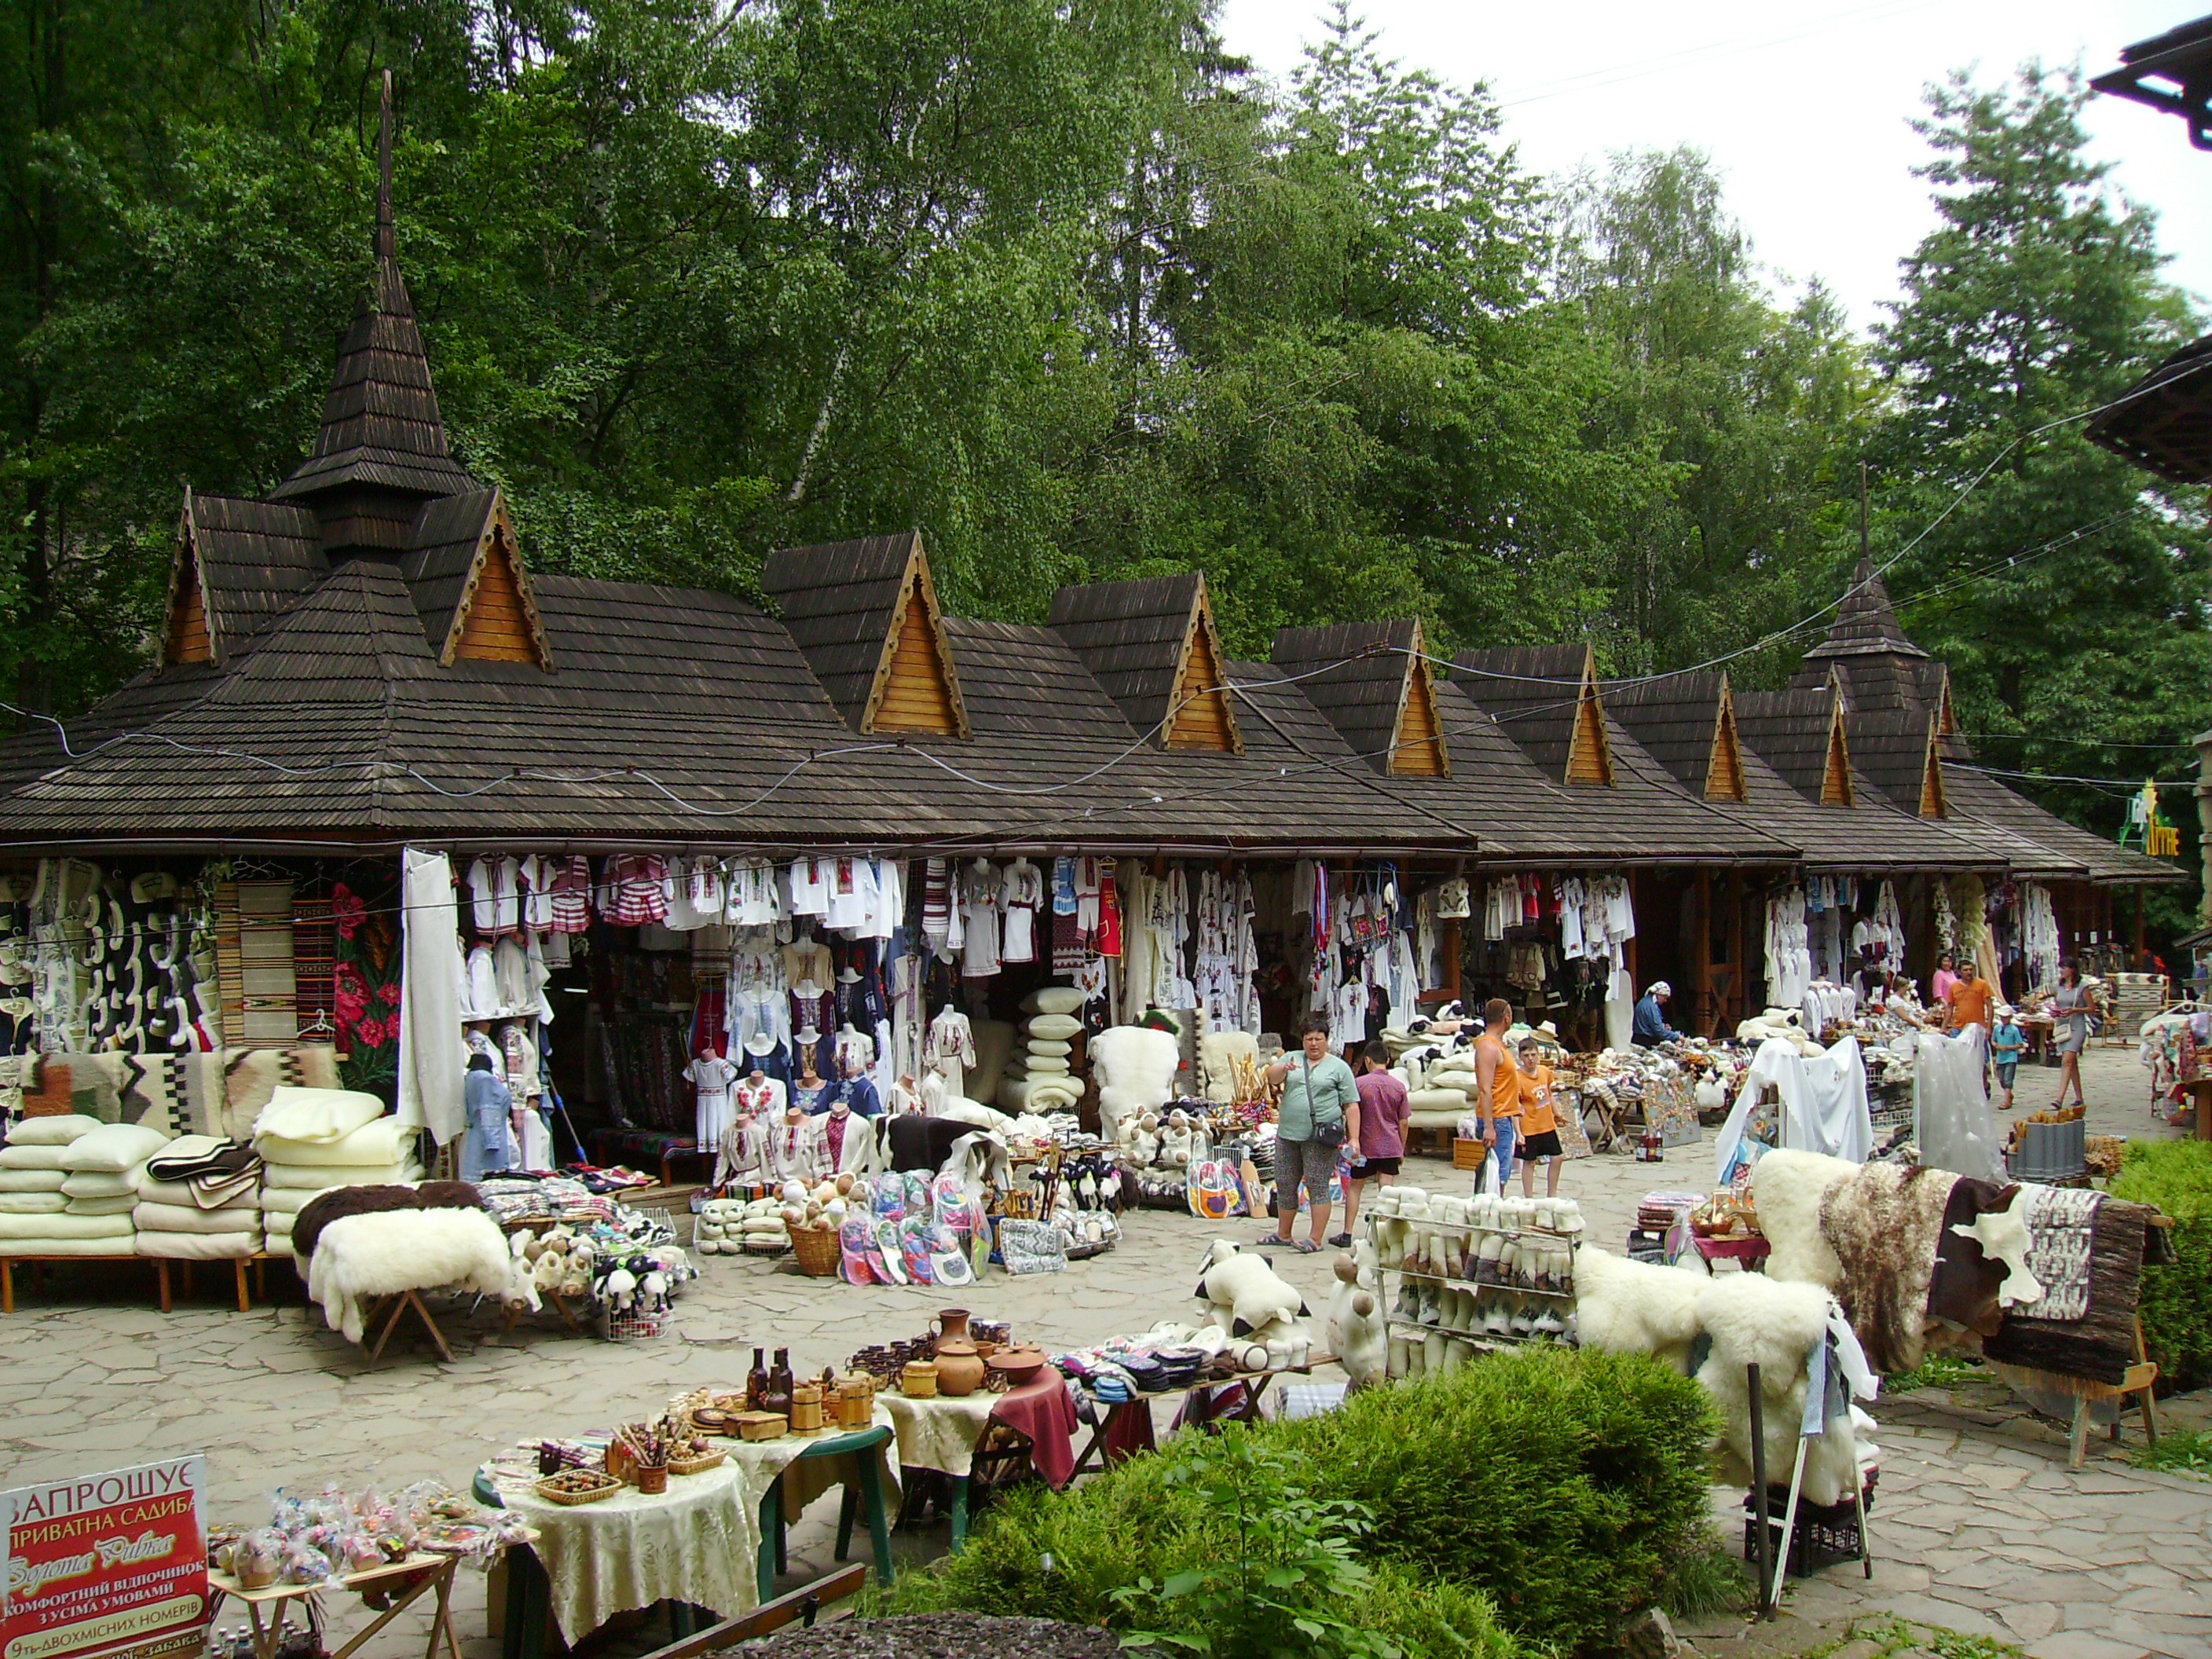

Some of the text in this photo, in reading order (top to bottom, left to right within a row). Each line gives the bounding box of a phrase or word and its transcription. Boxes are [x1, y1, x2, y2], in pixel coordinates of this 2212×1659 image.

[9, 1511, 116, 1550] ПРИВАТНА
[8, 1531, 174, 1595] Золота Рибка
[5, 1559, 206, 1617] КОМФОРТНИЙ ВІДПОЧИНОК
[50, 1601, 99, 1623] УСІМА
[102, 1581, 174, 1610] УМОВАМИ
[140, 1601, 199, 1627] НОМЕРІВ
